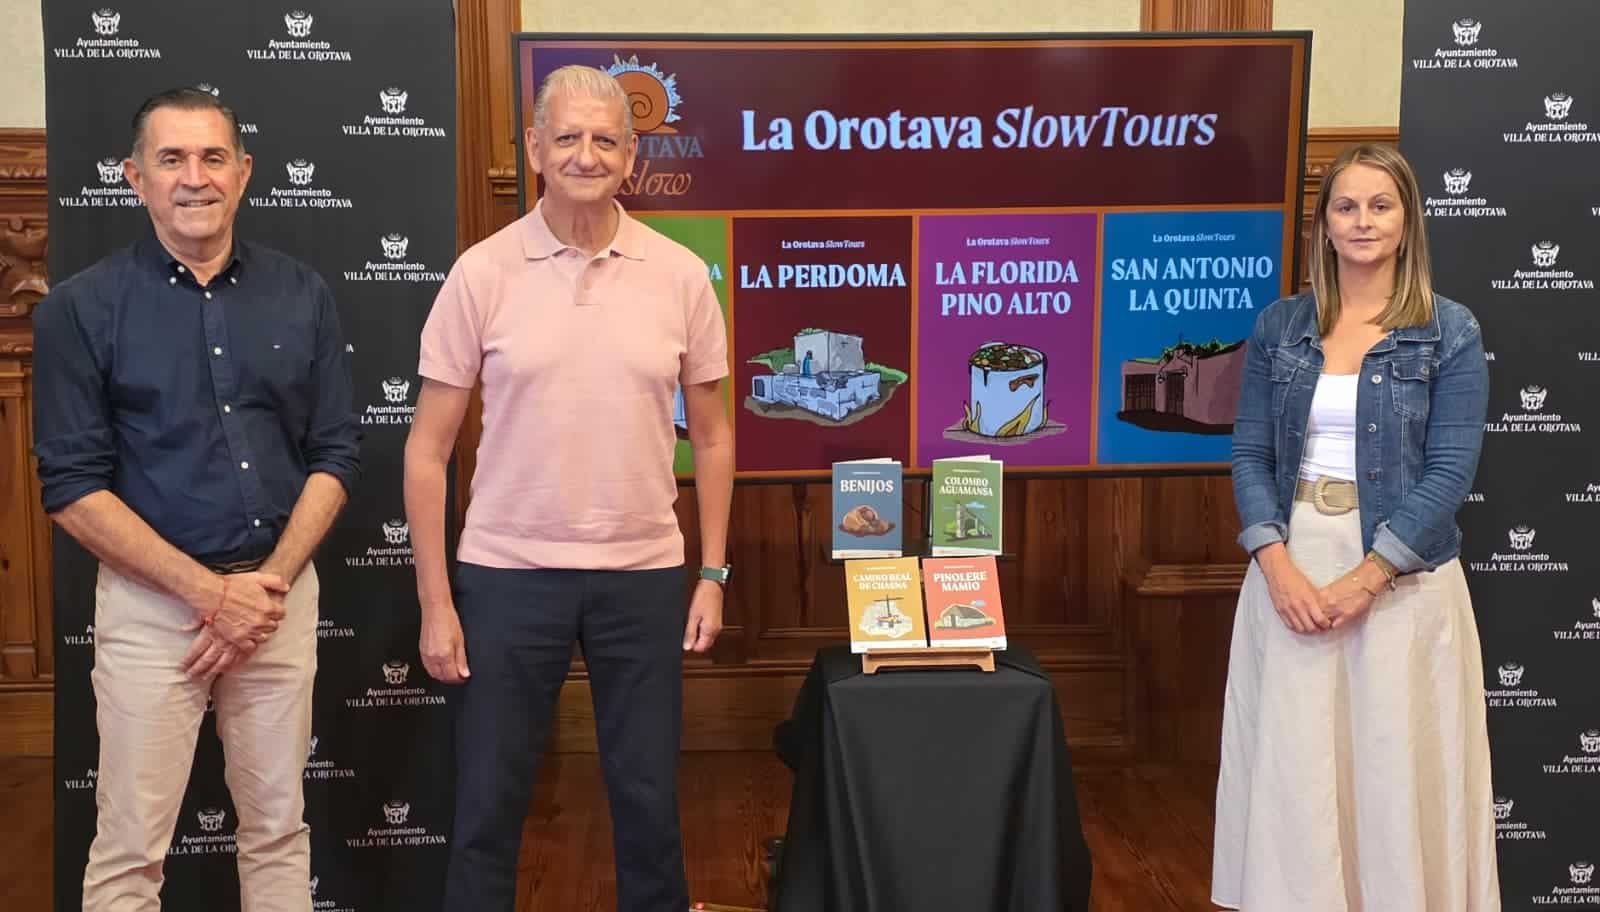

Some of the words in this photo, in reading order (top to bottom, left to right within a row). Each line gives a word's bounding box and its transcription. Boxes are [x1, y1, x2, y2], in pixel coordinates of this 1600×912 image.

[76, 38, 138, 47] Ayuntamiento
[269, 39, 330, 49] Ayuntamiento
[54, 49, 82, 57] VILLA
[87, 49, 99, 58] DE
[102, 49, 114, 58] LA
[116, 49, 160, 58] OROTAVA
[247, 50, 274, 59] VILLA
[278, 51, 291, 60] DE
[293, 51, 305, 60] LA
[308, 51, 351, 61] OROTAVA
[1435, 48, 1496, 58] Ayuntamiento
[1413, 60, 1441, 68] VILLA
[1444, 60, 1456, 68] DE
[1459, 60, 1471, 68] LA
[1474, 58, 1518, 69] OROTAVA
[364, 115, 424, 126] Ayuntamiento
[342, 126, 370, 135] VILLA
[374, 126, 386, 135] DE
[388, 127, 400, 136] LA
[402, 127, 445, 137] OROTAVA
[742, 110, 794, 150] La
[804, 110, 984, 150] Orotava
[992, 105, 1218, 148] SlowTours
[1526, 122, 1587, 132] Ayuntamiento
[1504, 133, 1531, 142] VILLA
[1534, 134, 1546, 142] DE
[1549, 133, 1561, 142] LA
[1563, 133, 1600, 143] OROTAV
[638, 136, 704, 158] TAVA
[82, 186, 136, 196] Ayuntamien
[271, 187, 331, 197] Ayuntamiento
[59, 197, 87, 206] VILLA
[91, 198, 103, 207] DE
[105, 198, 118, 207] LA
[249, 198, 277, 207] VILLA
[280, 198, 292, 207] DE
[295, 198, 307, 207] LA
[310, 198, 352, 208] OROTAVA
[1426, 198, 1486, 206] Ayuntamiento
[1435, 208, 1447, 216] DE
[1449, 208, 1461, 216] LA
[1463, 208, 1506, 217] OROTAVA
[966, 238, 976, 246] La
[978, 238, 1009, 246] Orotava
[1164, 234, 1195, 242] Orotava
[365, 262, 424, 272] Ayuntamiento
[1112, 258, 1158, 281] SAN
[1162, 256, 1273, 279] ANTONIO
[344, 272, 371, 281] VILLA
[375, 273, 387, 281] DE
[403, 272, 445, 282] OROTAVA
[741, 265, 772, 288] LA
[778, 264, 906, 288] PERDOMA
[936, 262, 967, 285] LA
[972, 260, 1079, 284] FLORIDA
[1514, 270, 1573, 279] Ayuntamiento
[1492, 280, 1518, 288] VILLA
[1536, 280, 1548, 288] LA
[1551, 280, 1594, 290] OROTAVA
[941, 292, 1002, 316] PINO
[1008, 291, 1071, 314] ALTO
[1129, 289, 1158, 311] LA
[1164, 287, 1254, 315] QUINTA
[376, 416, 388, 424] DE
[390, 416, 402, 424] LA
[1502, 413, 1561, 422] Ayuntamiento
[1511, 424, 1523, 432] DE
[1539, 424, 1581, 433] OROTAVA
[944, 476, 988, 486] COLOMBO
[840, 480, 894, 495] BENIJOS
[1565, 494, 1592, 502] VILLA
[367, 547, 411, 555] Ayuntamie
[346, 557, 373, 566] VILLA
[376, 558, 389, 566] DE
[390, 557, 402, 565] LA
[1491, 553, 1549, 562] Ayuntamiento
[1470, 563, 1496, 572] VILLA
[1513, 563, 1525, 571] LA
[1527, 562, 1568, 572] OROTAVA
[942, 582, 980, 593] MAMIO
[65, 636, 93, 644] VILLA
[1554, 632, 1580, 640] VILLA
[367, 688, 425, 696] Ayuntamiento
[346, 698, 373, 707] VILLA
[404, 696, 446, 706] OROTAVA
[1516, 698, 1556, 708] OROTAVA
[1563, 756, 1600, 764] Ayuntami
[313, 770, 355, 779] OROTAVA
[66, 780, 93, 788] VILLA
[368, 827, 425, 836] Ayuntamiento
[1506, 831, 1546, 840] OROTAVA
[182, 835, 236, 844] Ayuntamient
[347, 839, 374, 847] VILLA
[405, 836, 446, 846] OROTAVA
[192, 846, 204, 854] DE
[1552, 886, 1600, 895] Ayuntamien
